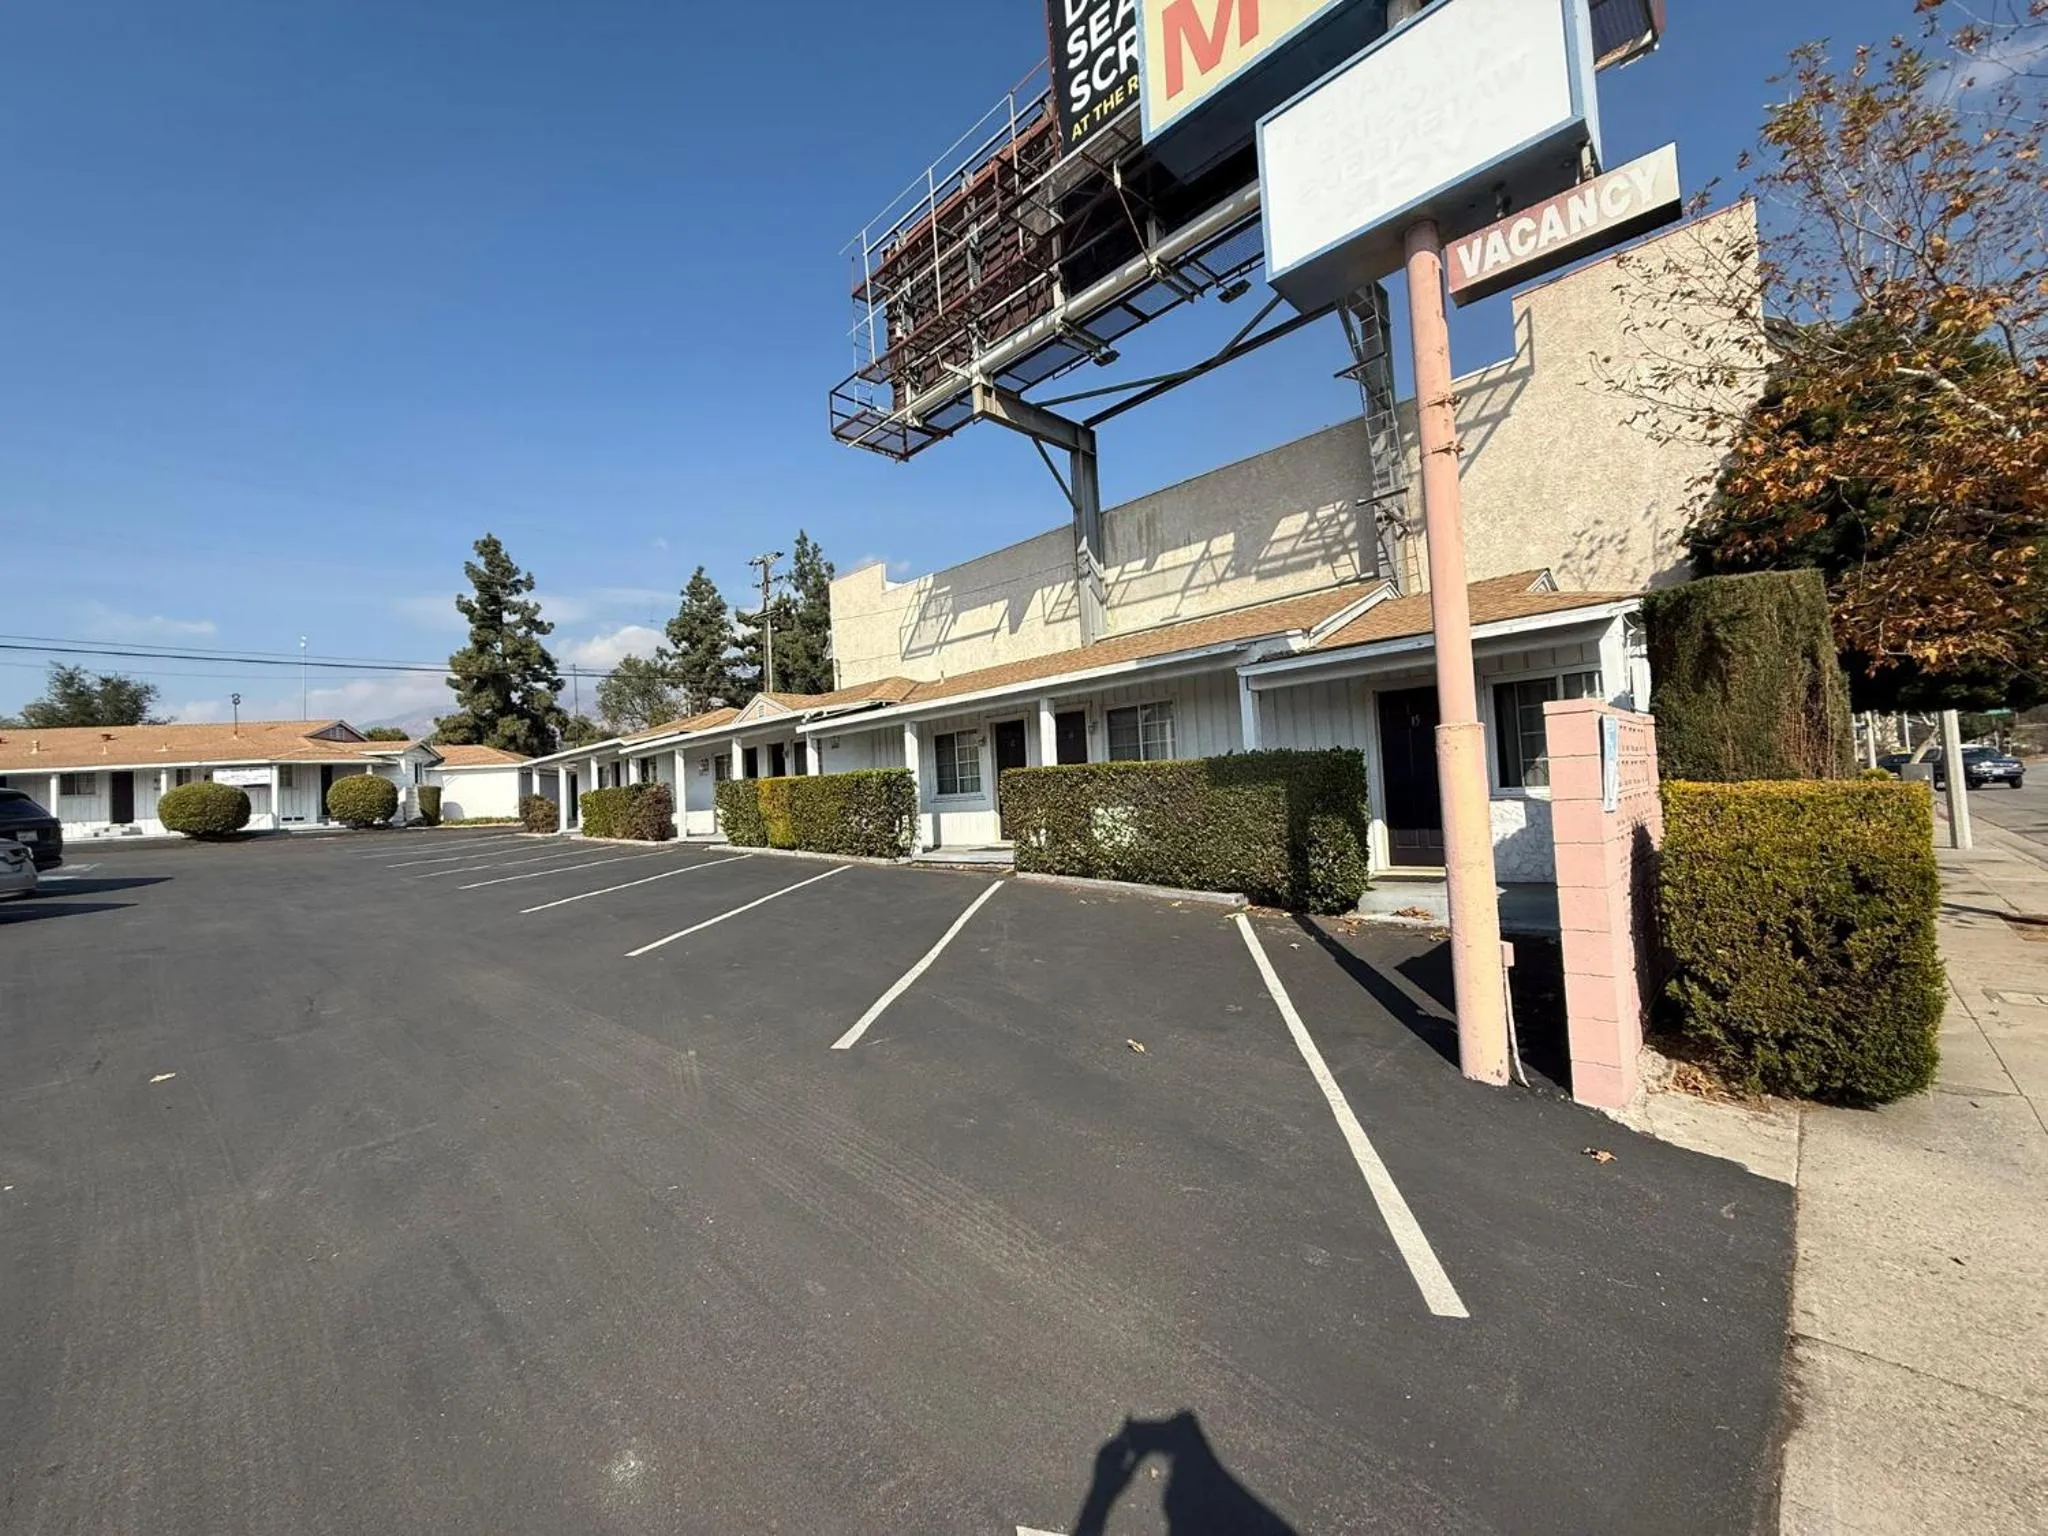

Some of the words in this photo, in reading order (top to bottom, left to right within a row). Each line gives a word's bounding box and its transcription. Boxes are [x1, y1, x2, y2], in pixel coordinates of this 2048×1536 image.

[1162, 0, 1259, 101] M
[1072, 114, 1090, 142] AT
[1093, 85, 1125, 121] THE
[1457, 159, 1665, 279] VACANCY
